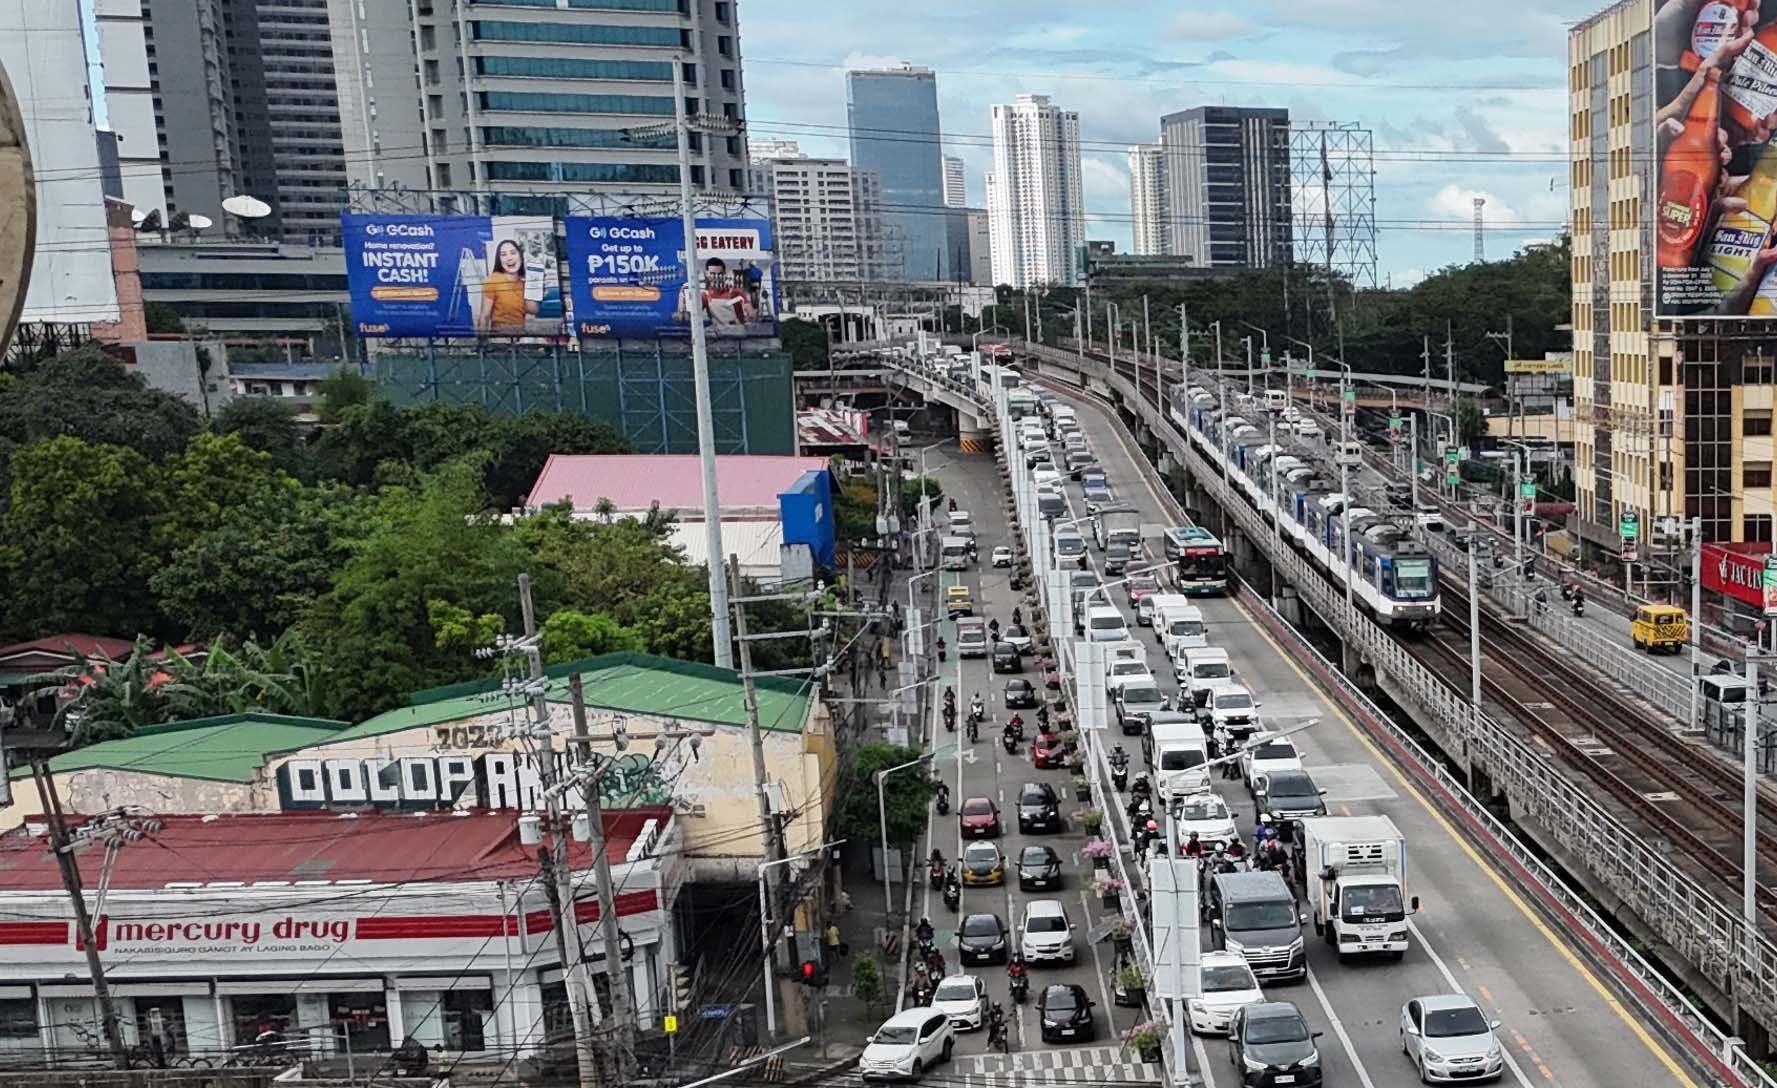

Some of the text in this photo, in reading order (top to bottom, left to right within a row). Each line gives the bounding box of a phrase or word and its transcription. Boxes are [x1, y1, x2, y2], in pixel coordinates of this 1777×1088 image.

[386, 224, 434, 236] GCash
[609, 227, 655, 239] GCash
[711, 236, 754, 249] EATERY
[1711, 244, 1752, 258] LIGHT
[362, 252, 440, 268] INSTANT
[377, 268, 429, 283] CASH!
[581, 323, 607, 334] fuse
[115, 917, 349, 943] mercury drug
